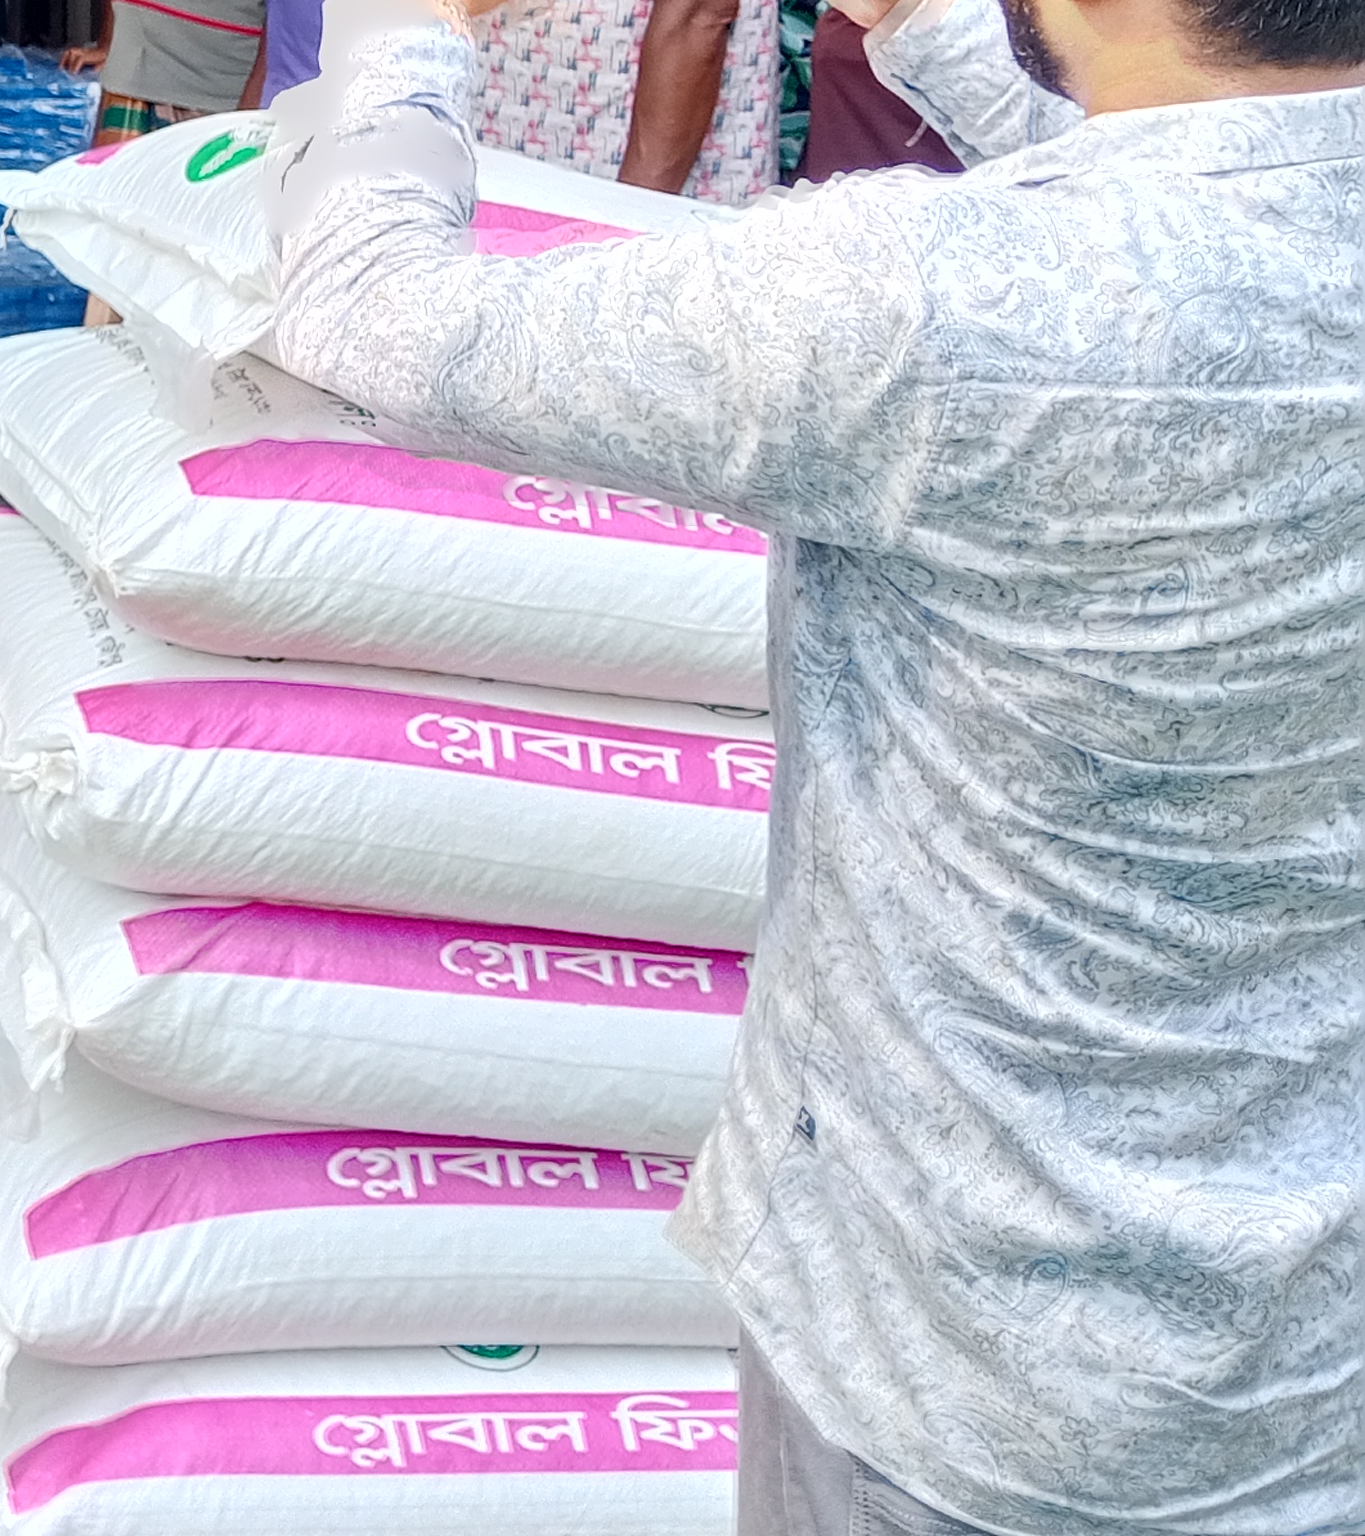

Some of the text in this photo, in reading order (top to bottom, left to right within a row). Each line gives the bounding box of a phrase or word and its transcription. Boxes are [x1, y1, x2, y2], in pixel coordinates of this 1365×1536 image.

[502, 476, 769, 539] গ্লোবা
[405, 708, 680, 789] গ্লোবাল
[438, 938, 713, 994] গ্লোবাল
[325, 1144, 597, 1199] গ্লোবাল
[311, 1409, 589, 1469] গ্লোবাল
